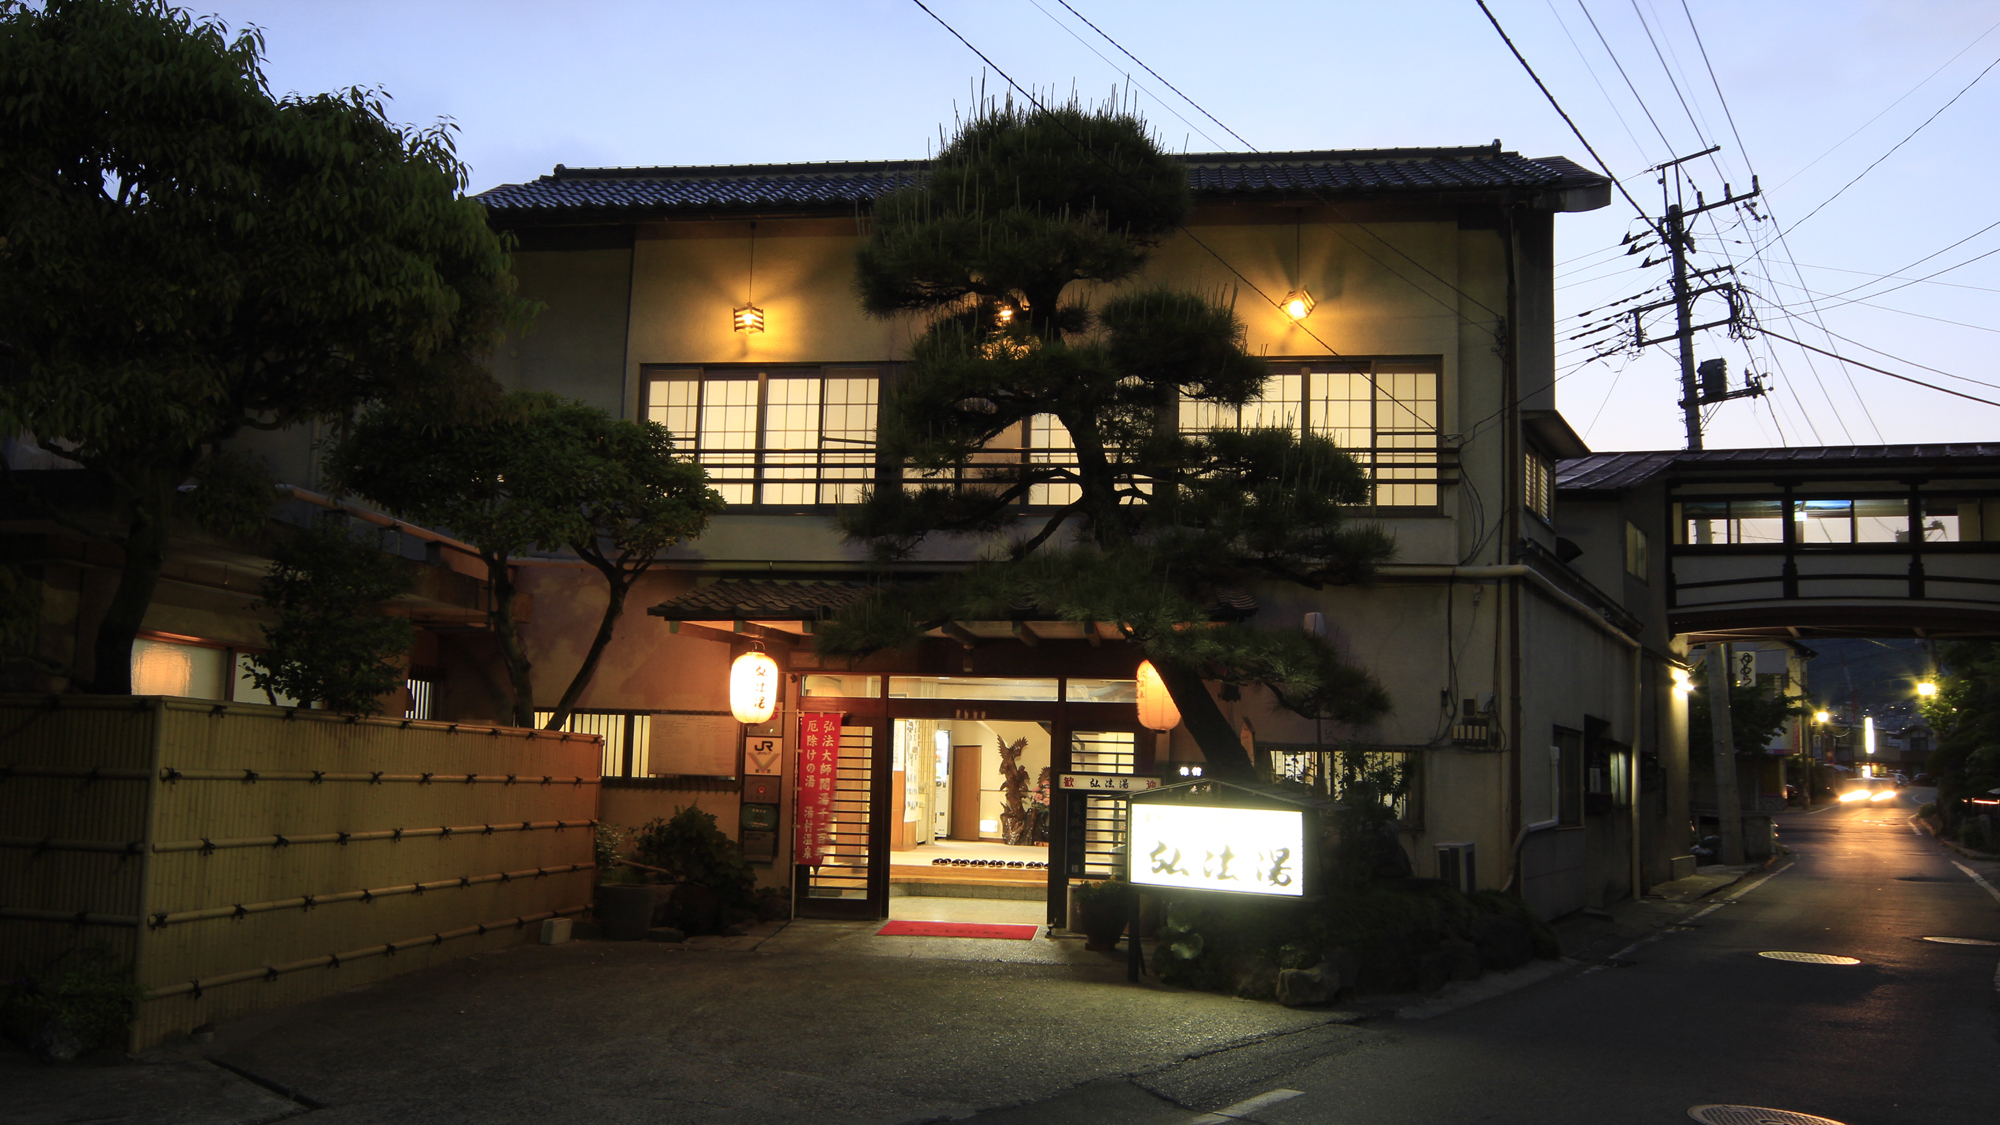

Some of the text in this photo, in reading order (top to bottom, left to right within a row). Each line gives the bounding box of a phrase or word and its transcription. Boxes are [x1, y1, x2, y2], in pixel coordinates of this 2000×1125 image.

[754, 741, 773, 752] JR
[802, 720, 819, 860] 厄除けの湯 湯村温泉
[1149, 840, 1293, 887] 弘法湯
